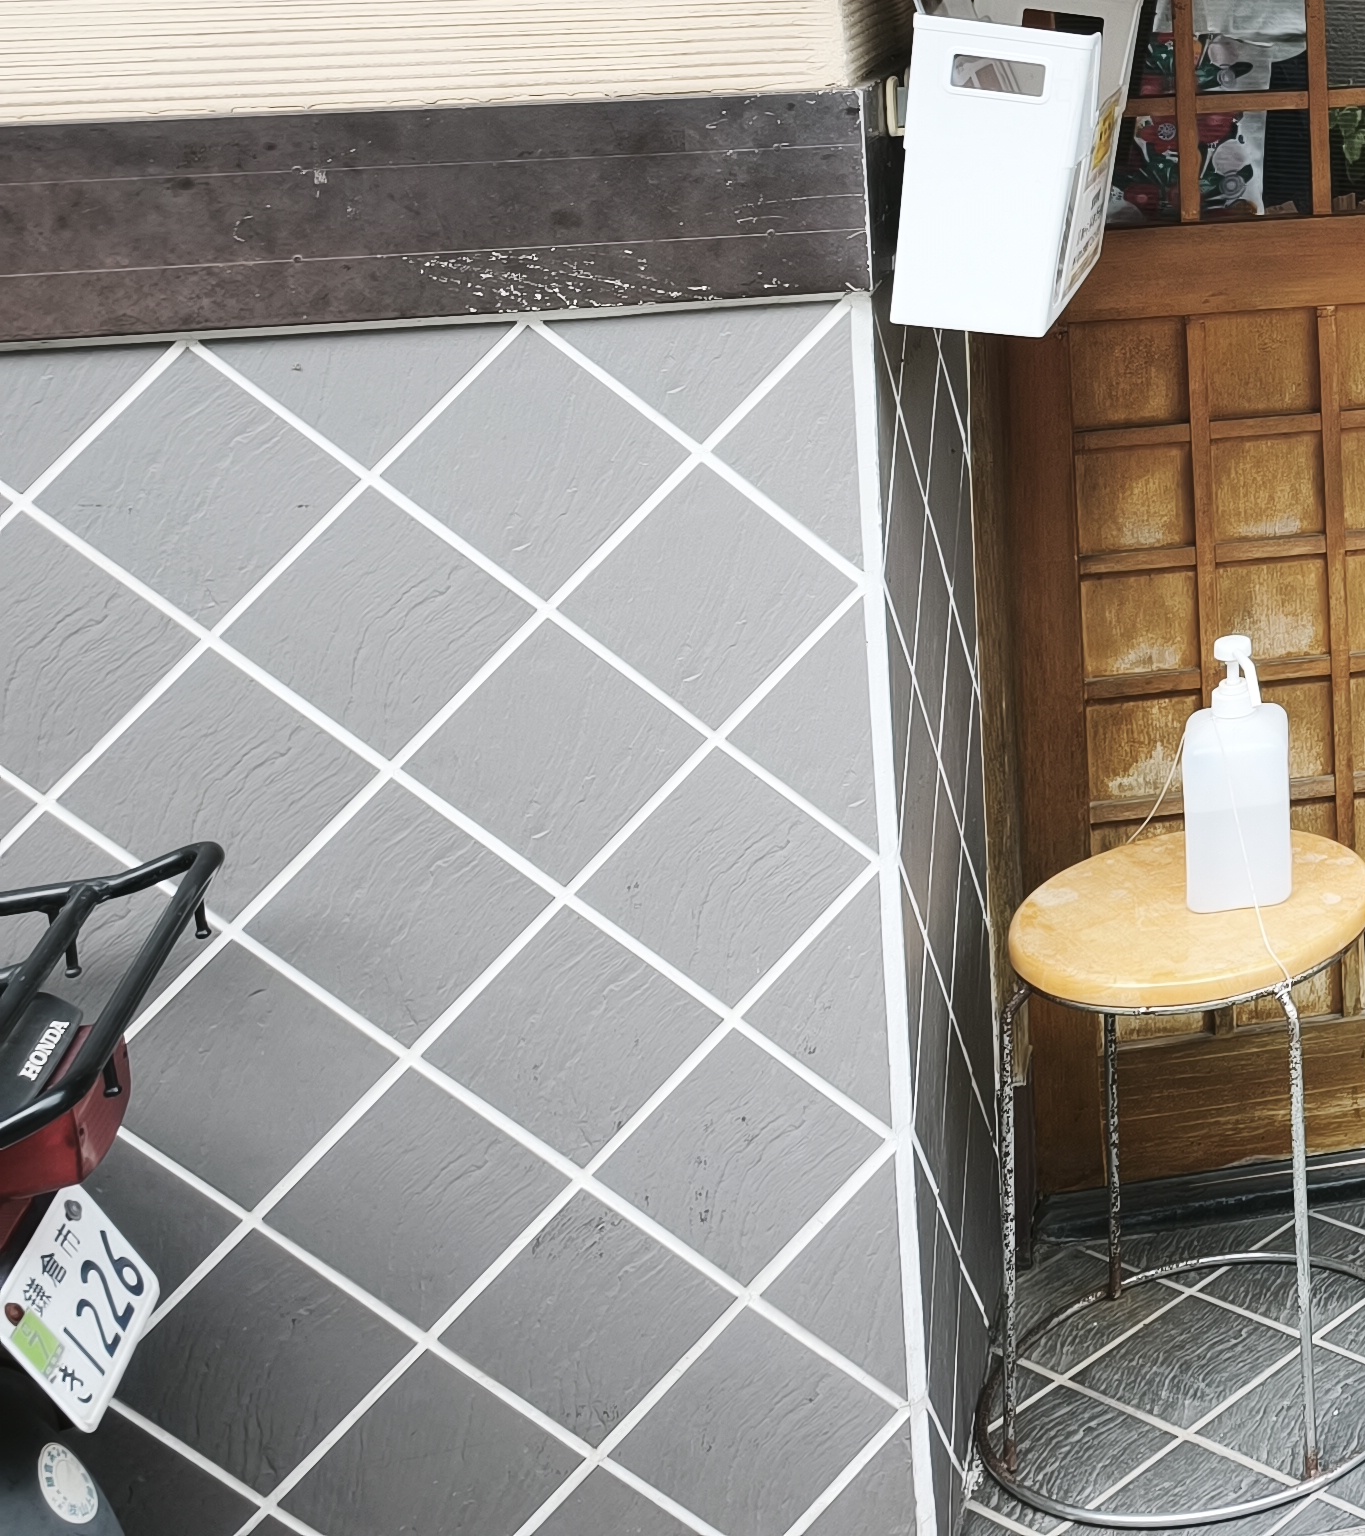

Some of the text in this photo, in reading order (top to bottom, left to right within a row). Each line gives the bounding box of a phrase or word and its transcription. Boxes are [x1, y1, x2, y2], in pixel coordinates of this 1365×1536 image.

[17, 1020, 70, 1081] HONDA
[22, 1223, 81, 1317] 鎌倉市
[63, 1229, 145, 1376] 1226
